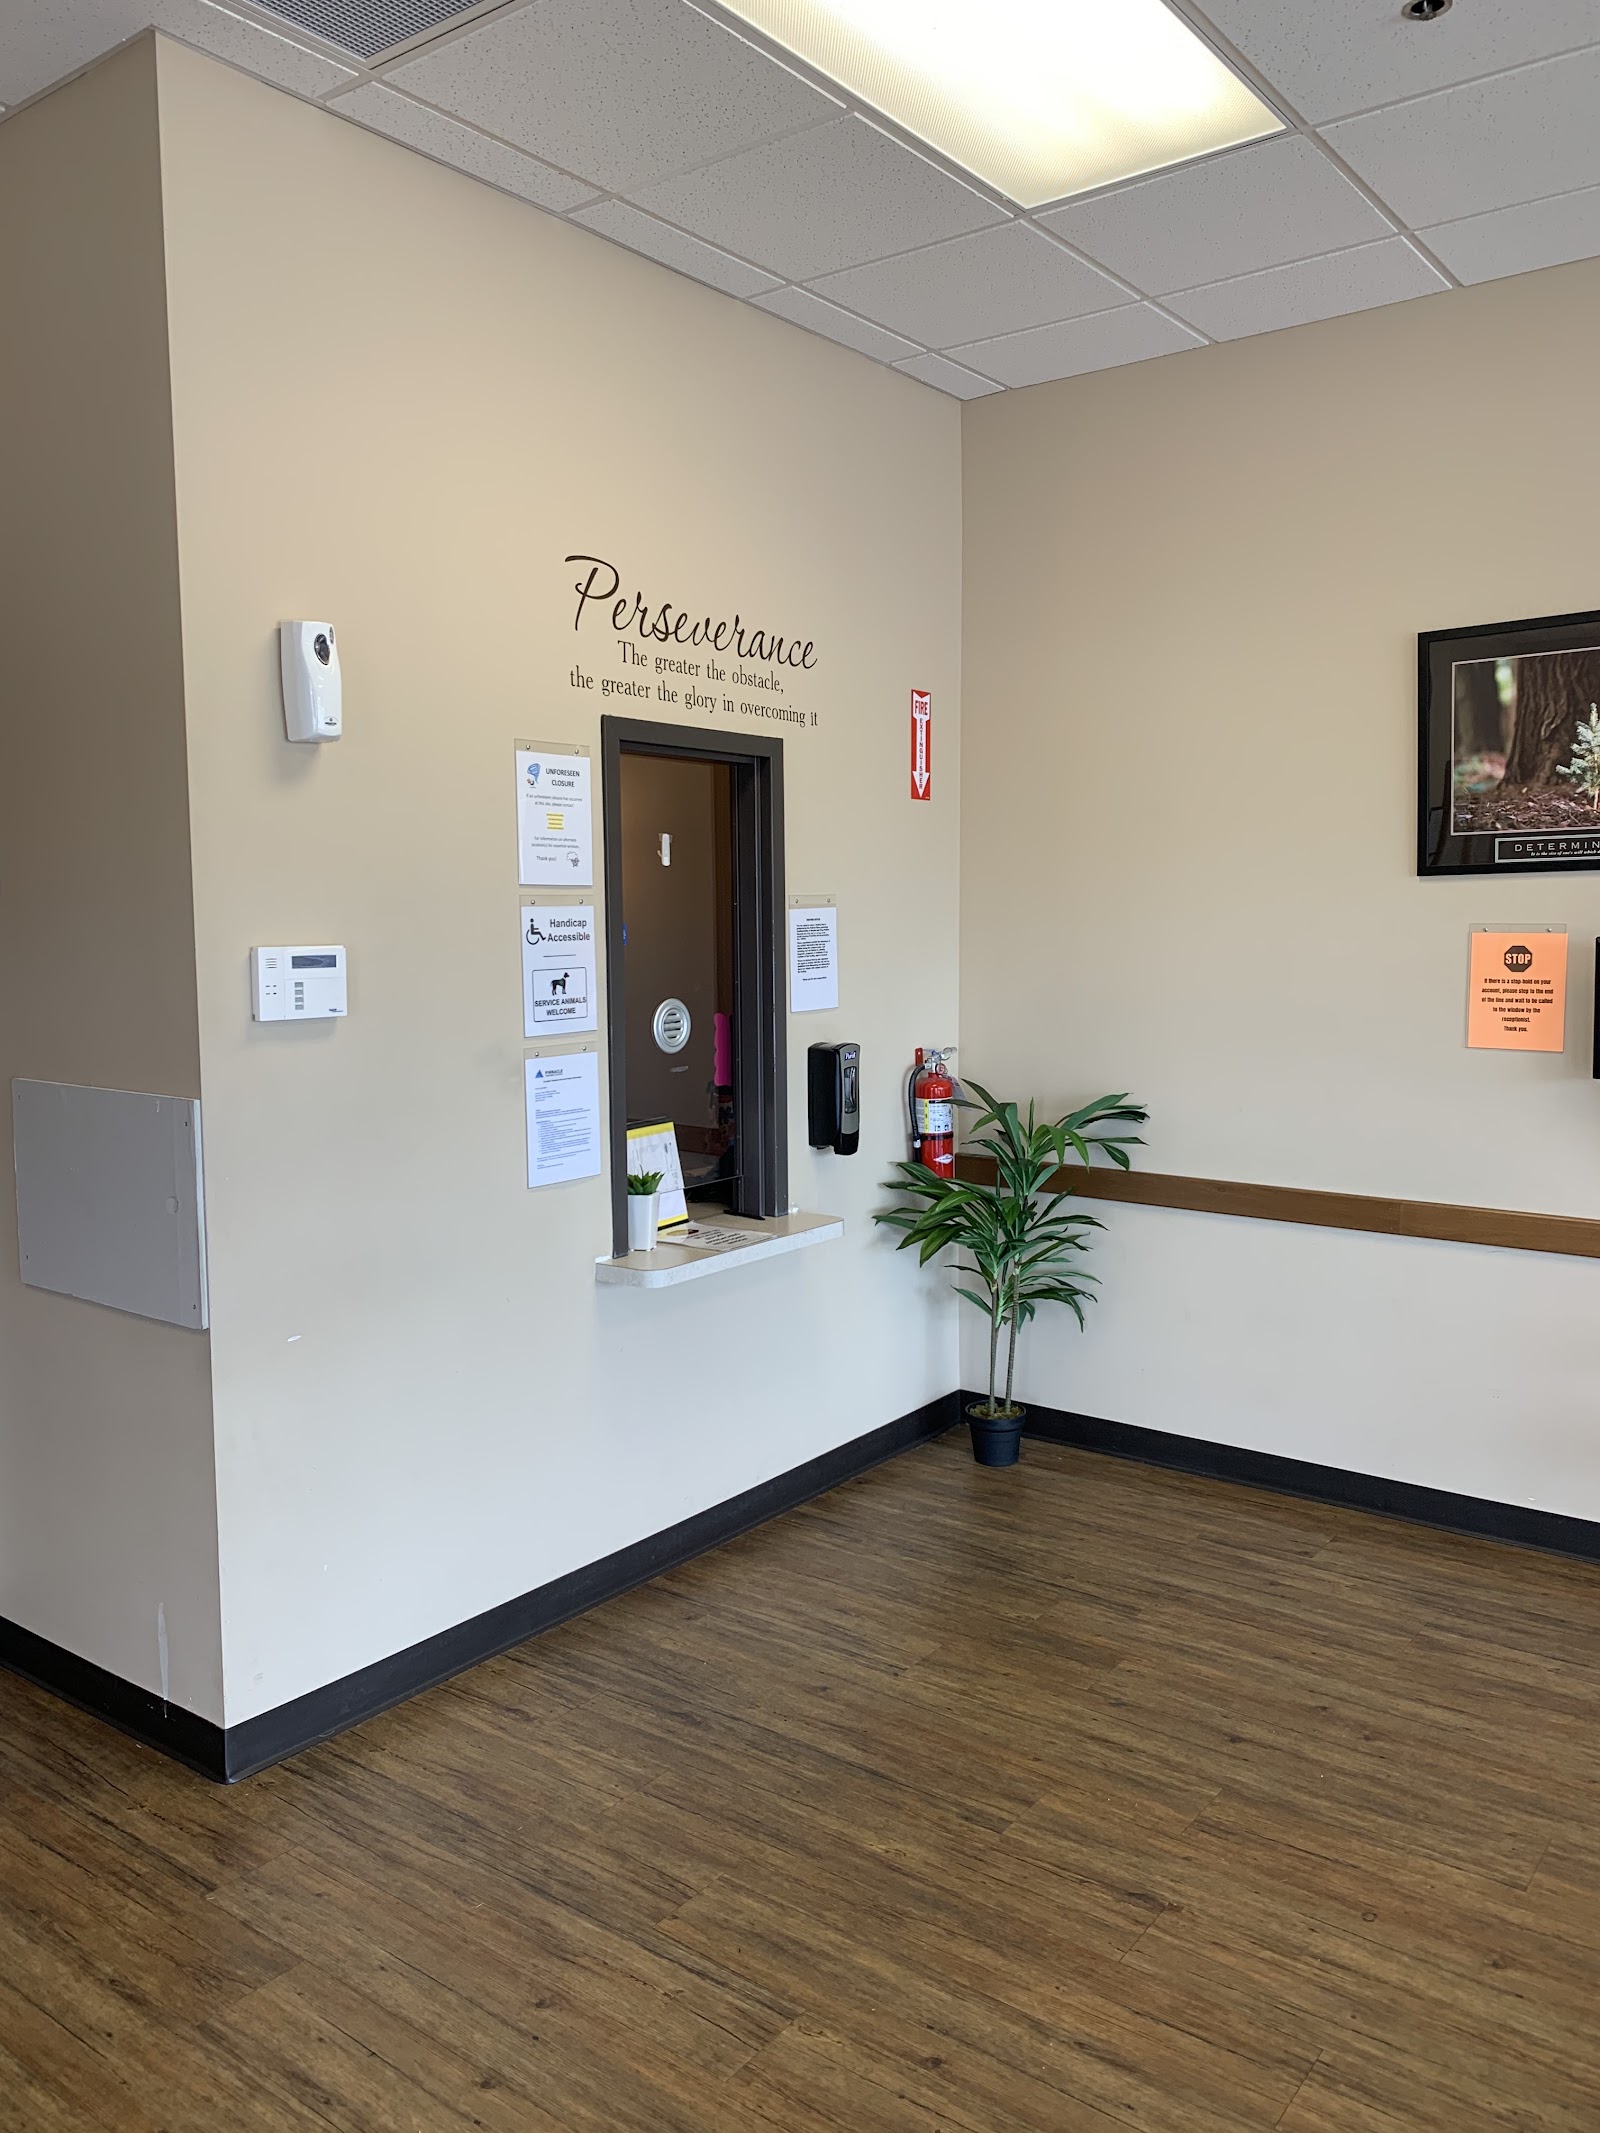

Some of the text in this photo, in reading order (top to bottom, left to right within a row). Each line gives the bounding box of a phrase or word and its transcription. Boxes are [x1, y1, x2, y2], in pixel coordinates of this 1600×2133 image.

[564, 555, 818, 669] Perseverance
[617, 640, 784, 695] The greater the obstacle,
[569, 665, 818, 728] the greater the glory in overcoming it
[915, 700, 928, 716] FIRE
[545, 768, 580, 777] UNFORESEEN
[551, 779, 575, 788] CLOSURE
[549, 918, 587, 929] Handicap
[547, 932, 591, 942] Accessible
[1505, 953, 1531, 965] STOP
[534, 996, 587, 1008] SERVICE ANIMALS
[546, 1007, 576, 1016] WELCOME
